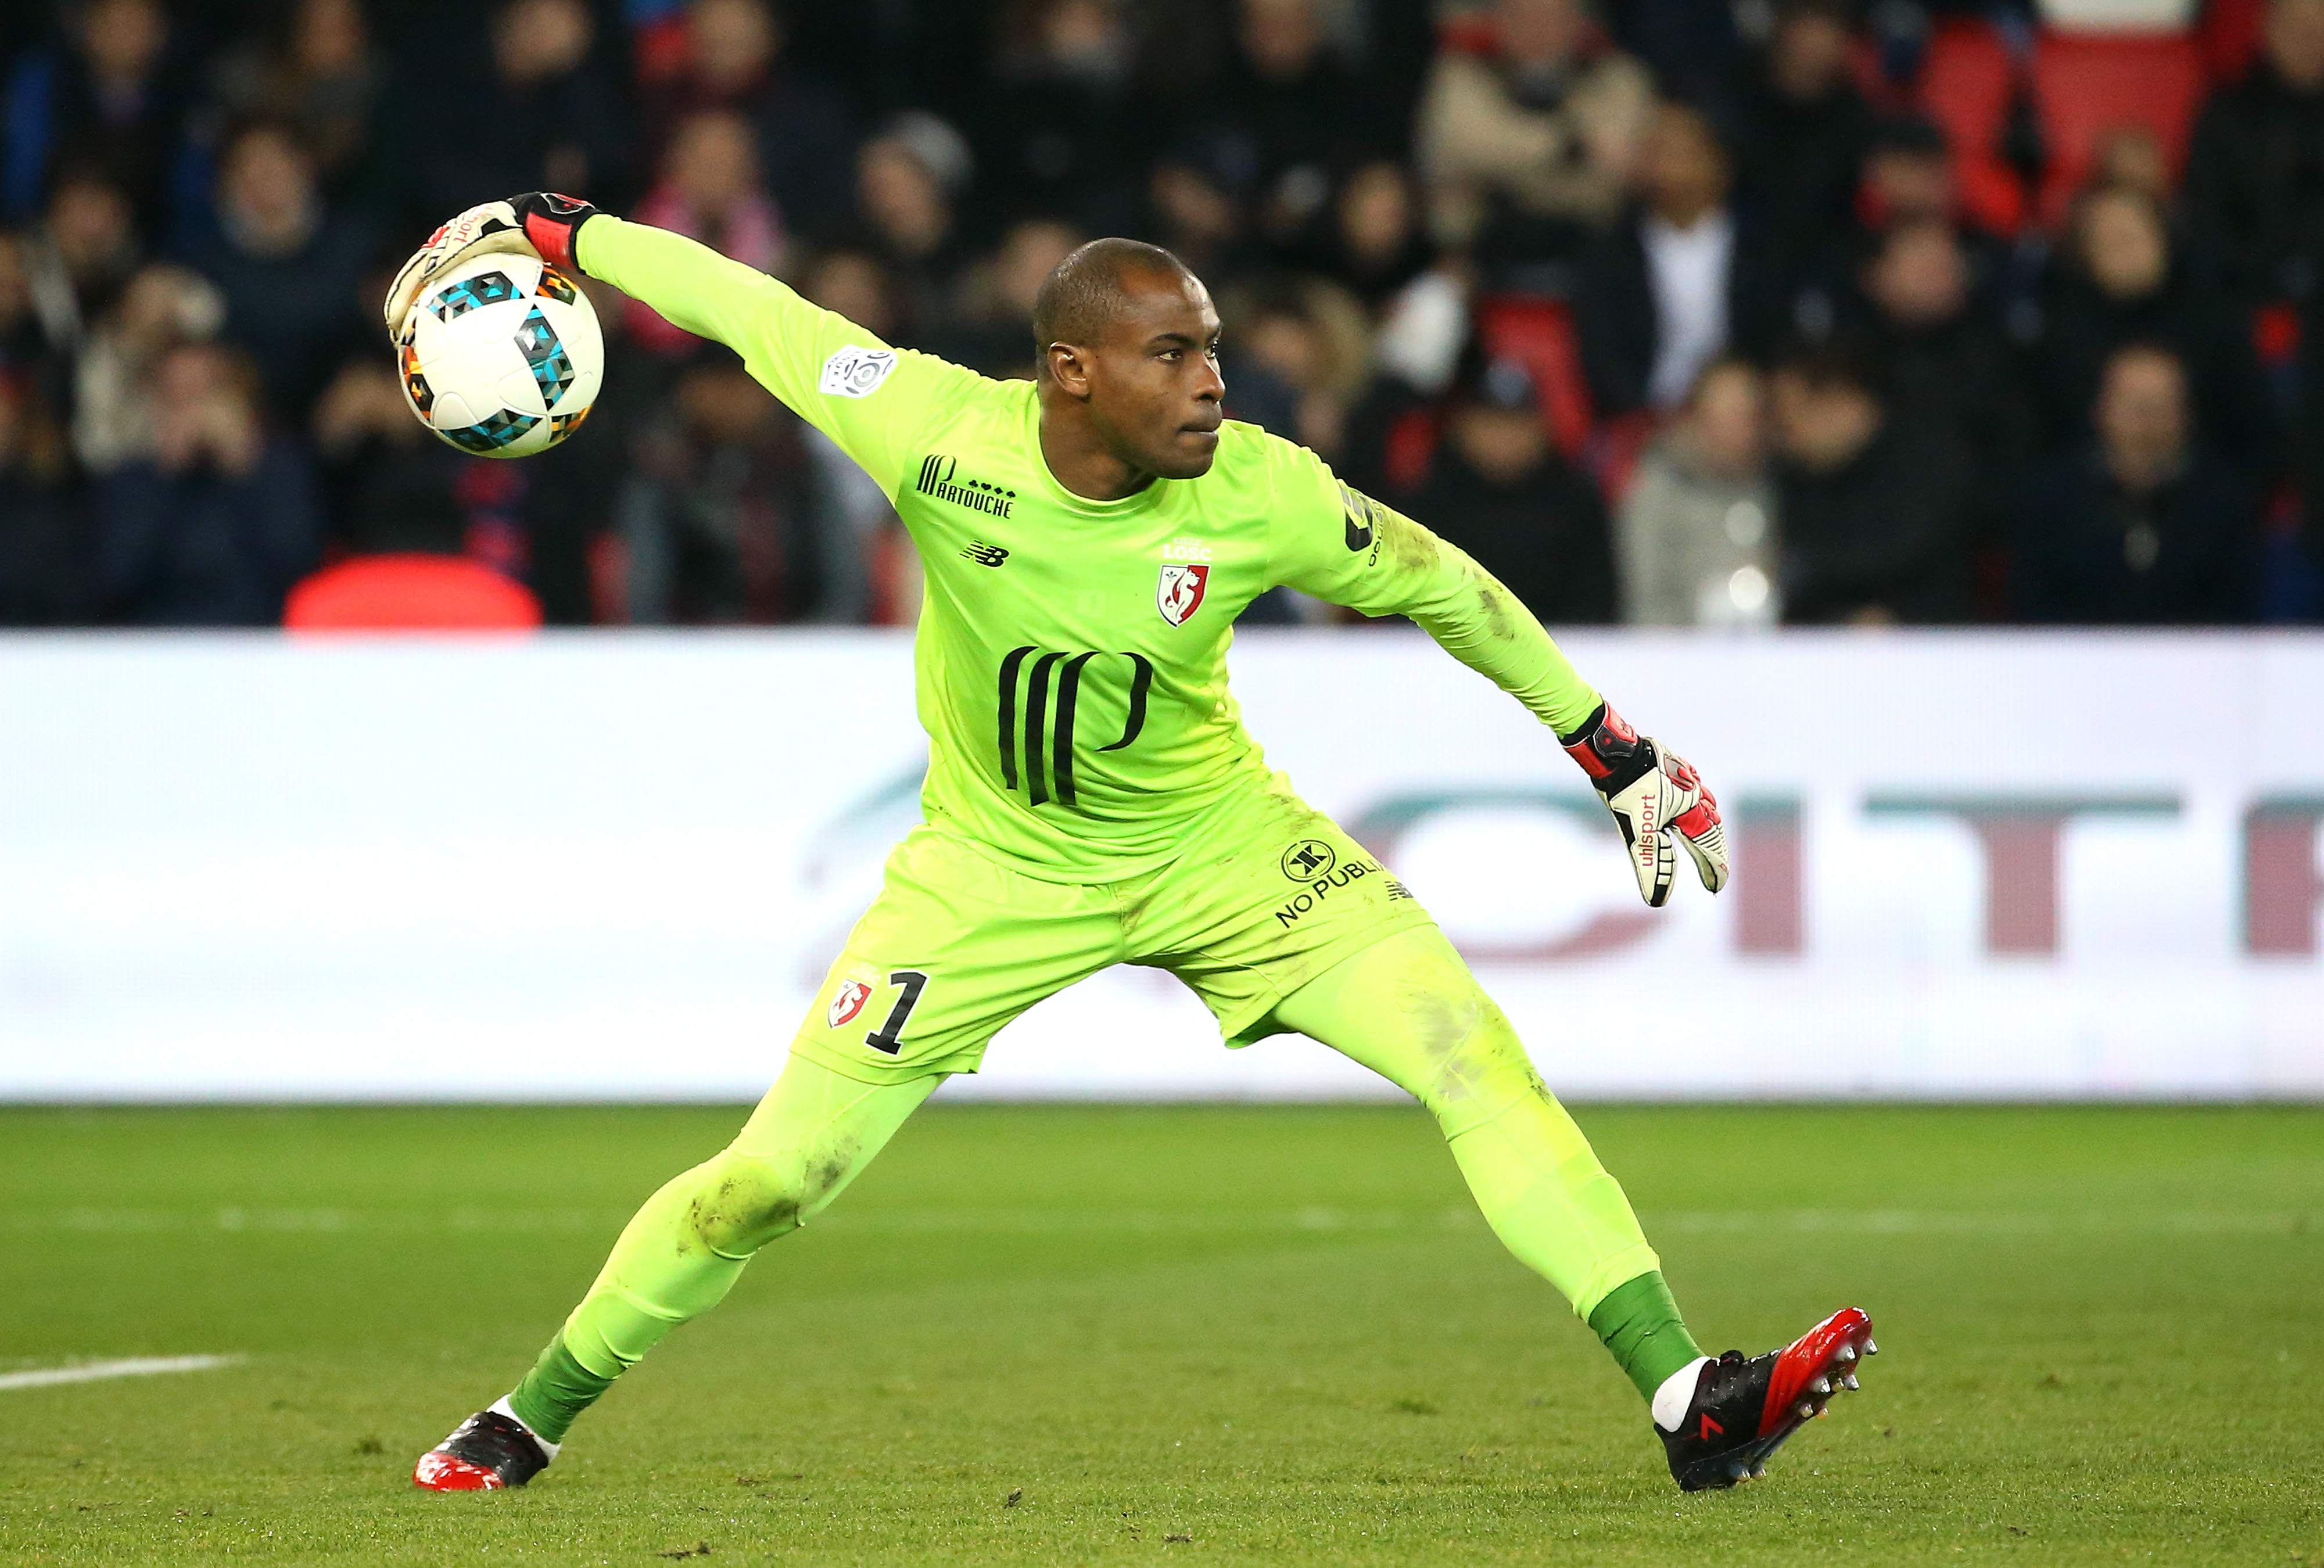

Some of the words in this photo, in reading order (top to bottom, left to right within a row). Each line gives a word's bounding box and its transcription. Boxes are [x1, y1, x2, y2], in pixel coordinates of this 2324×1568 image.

[916, 454, 1014, 519] PARTOUCHE
[1162, 544, 1212, 561] LOSC
[1639, 794, 1655, 866] uhlsport
[1275, 893, 1313, 928] NO
[1312, 858, 1385, 900] PUBLI
[865, 971, 928, 1056] 1
